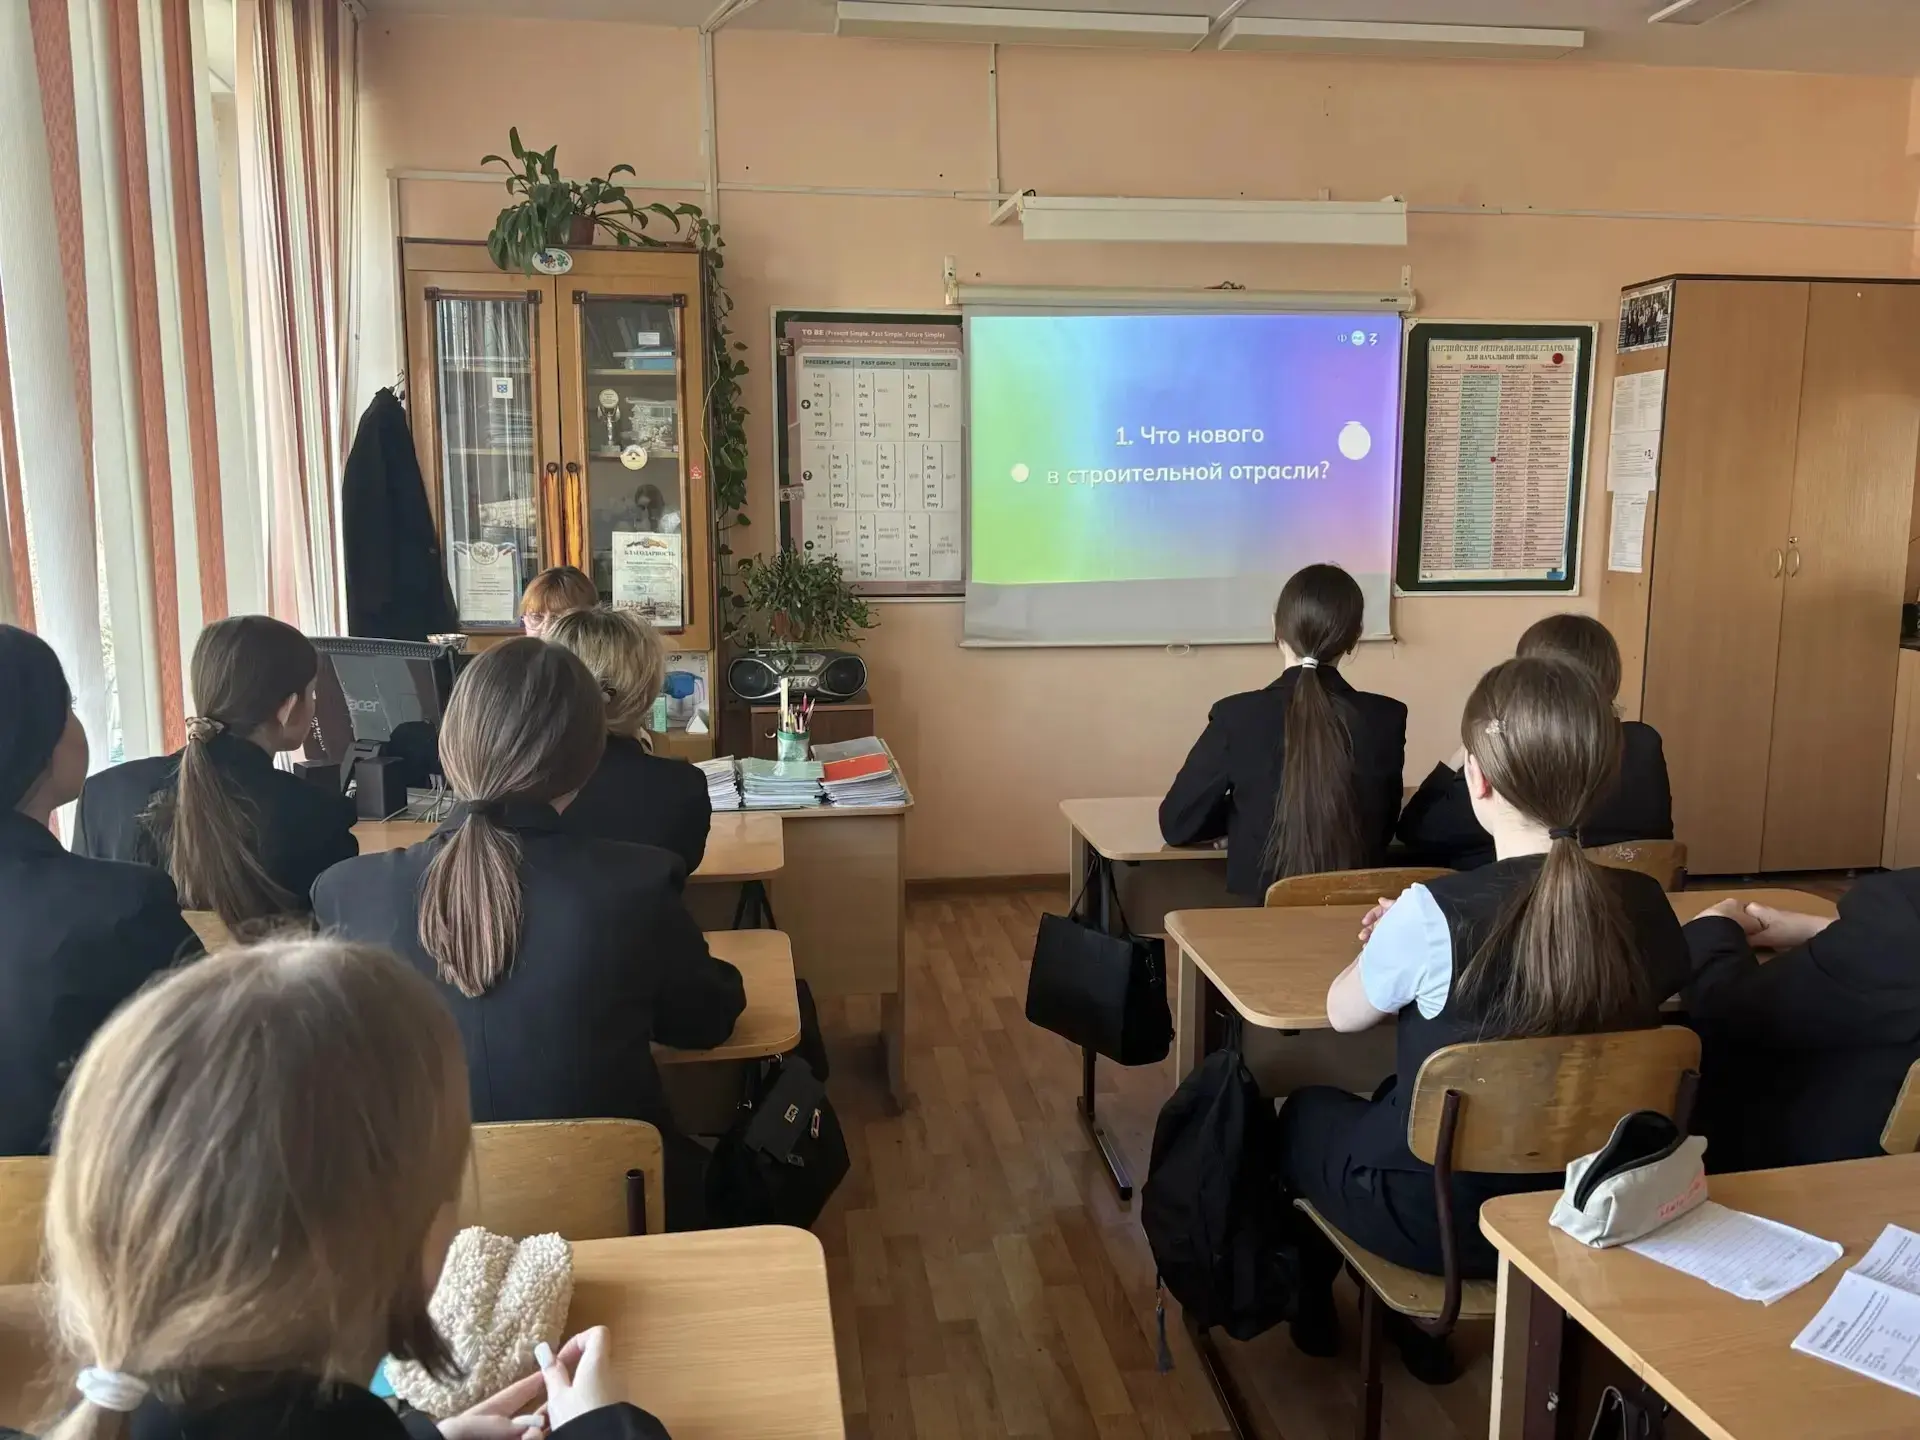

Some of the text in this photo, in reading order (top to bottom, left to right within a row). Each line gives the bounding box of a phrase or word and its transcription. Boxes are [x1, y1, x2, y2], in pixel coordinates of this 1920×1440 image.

[1115, 425, 1264, 446] 1. Что нового
[1048, 460, 1330, 488] в строительной отрасли?
[348, 700, 380, 712] acer
